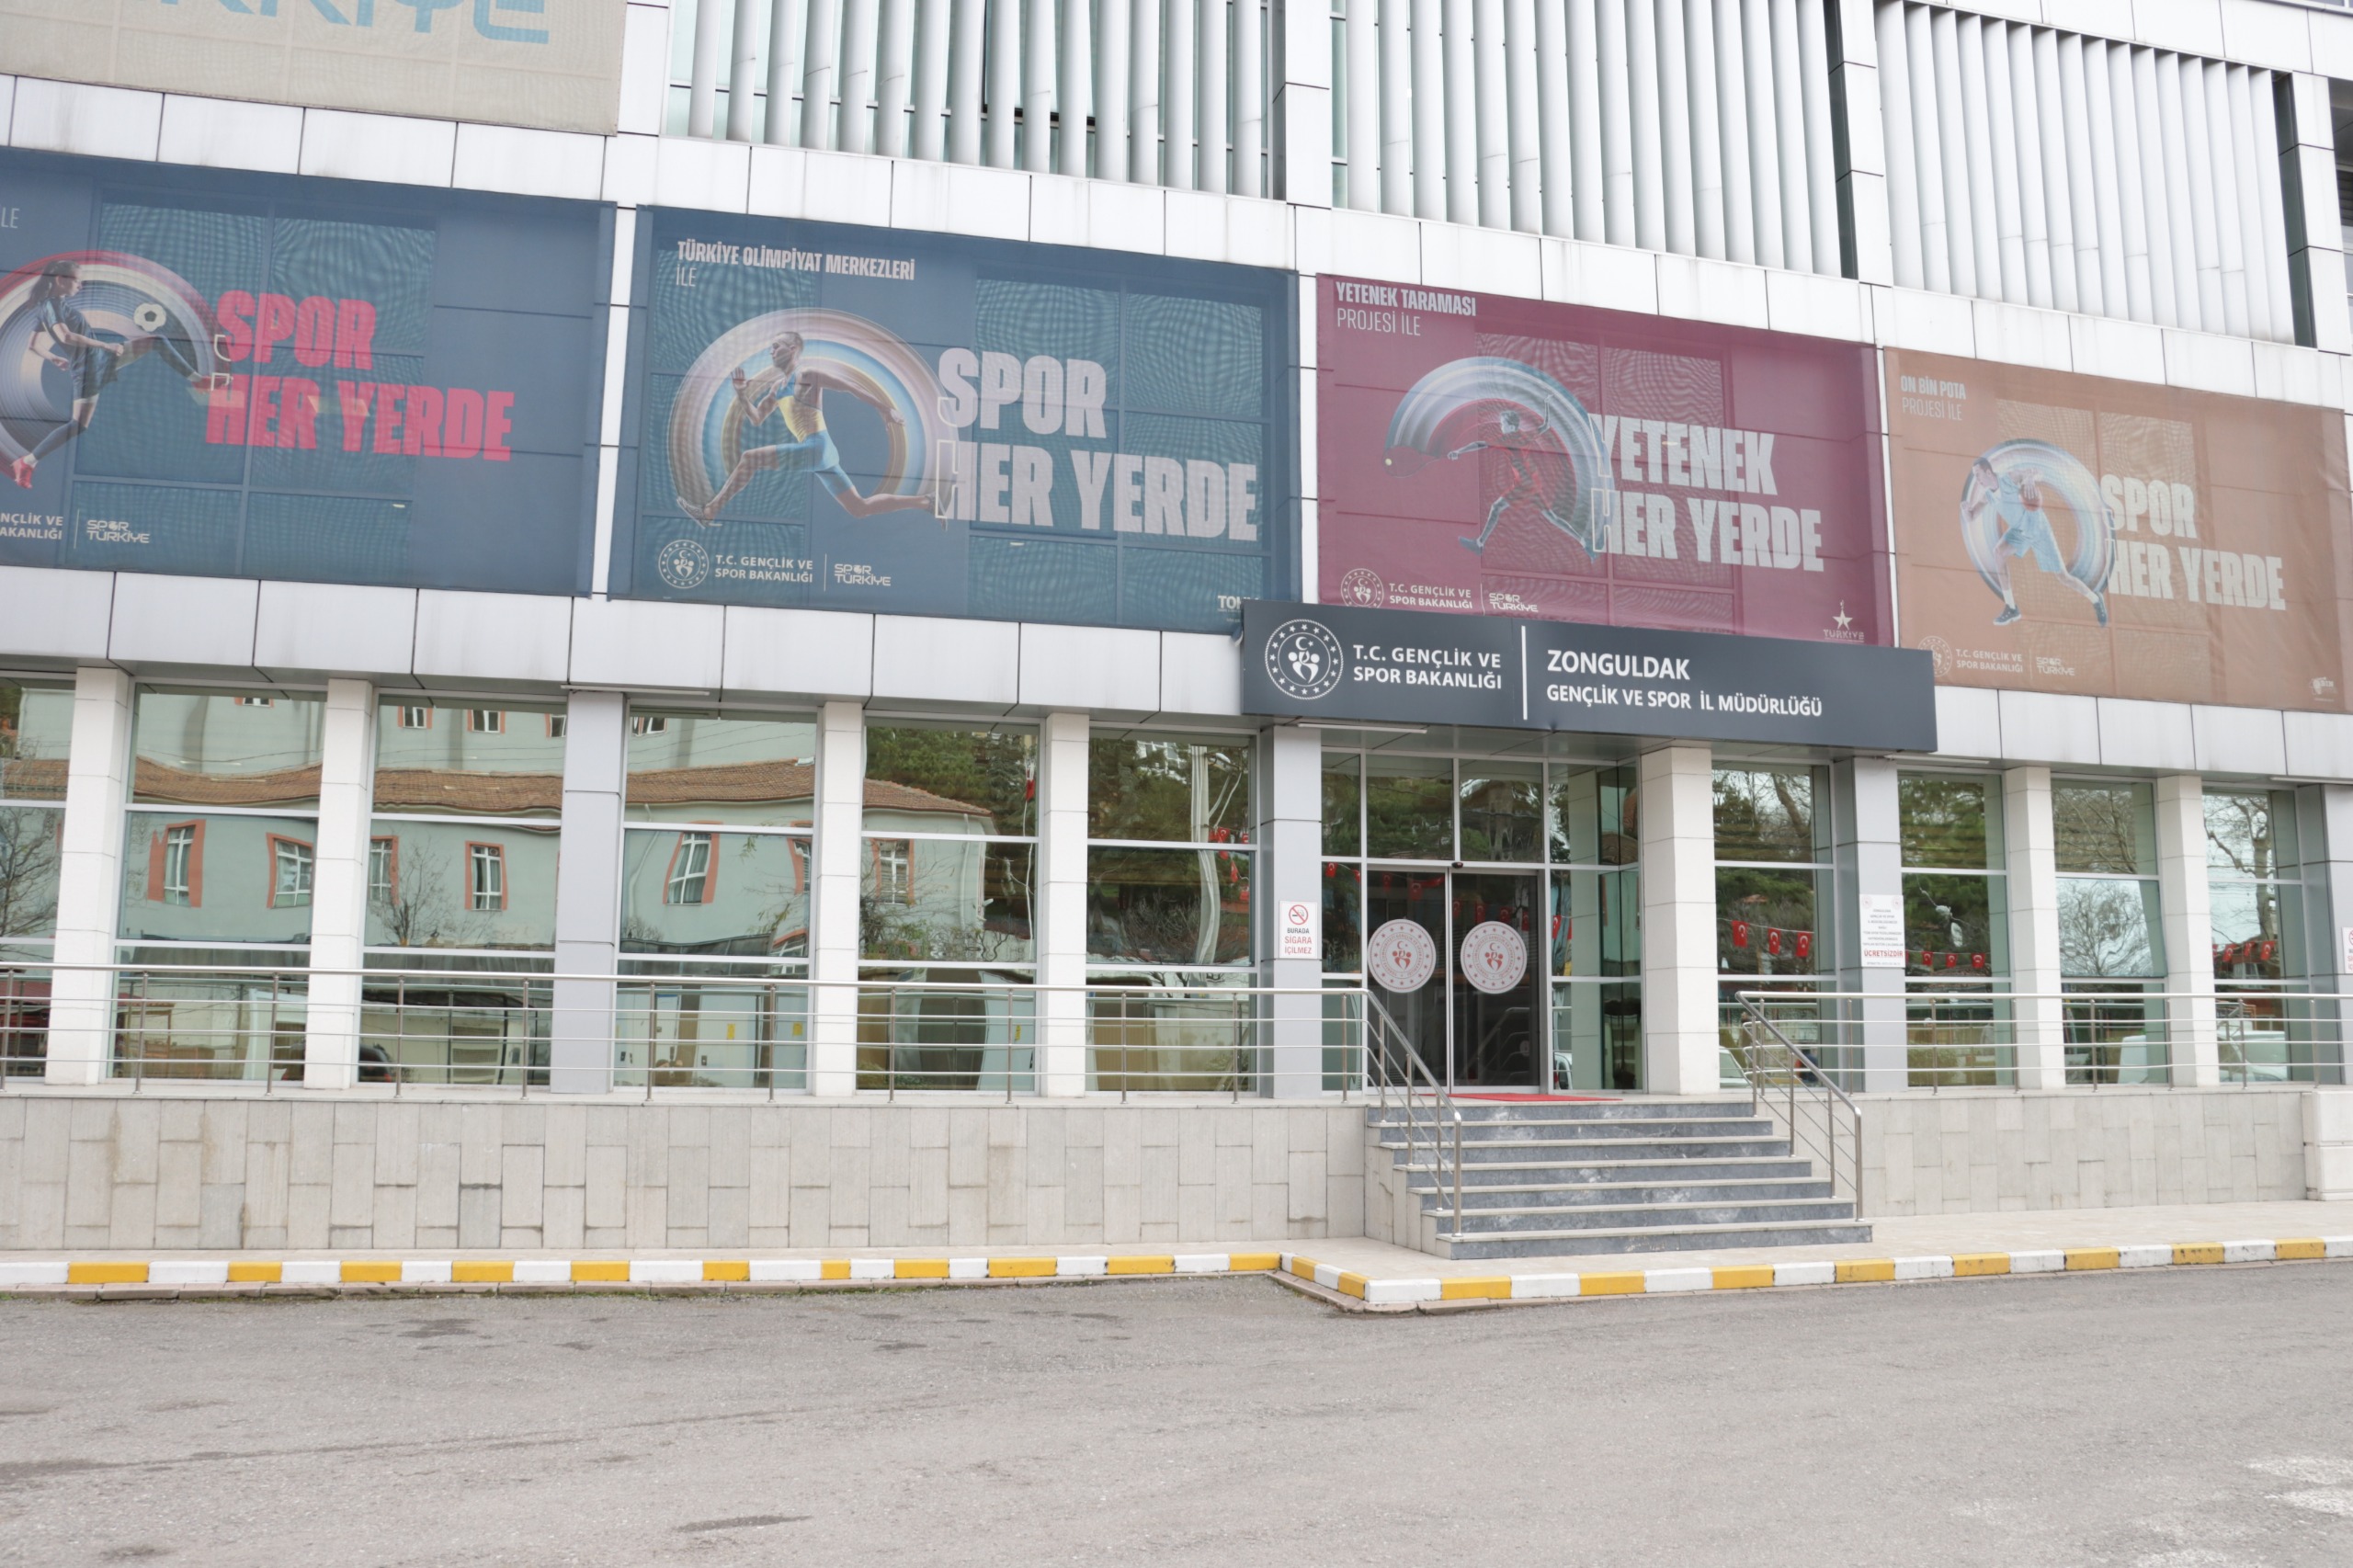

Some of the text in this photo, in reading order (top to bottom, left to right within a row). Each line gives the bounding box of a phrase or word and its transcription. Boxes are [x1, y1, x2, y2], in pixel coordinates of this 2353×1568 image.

[677, 238, 915, 280] TÜRKİYE OLİMPİYAT MERKEZLERİ
[676, 264, 697, 287] İLE
[1336, 281, 1476, 316] YETENEK TARAMASI
[214, 290, 376, 369] SPOR
[1337, 307, 1421, 336] PROJESİ İLE
[938, 347, 1108, 438] SPOR
[1900, 375, 1967, 400] ON BİN POTA
[206, 372, 515, 461] HER YERDE
[1902, 396, 1963, 421] PROJESİ İLE
[1587, 413, 1779, 495] YETENEK
[935, 439, 1257, 541] HER YERDE
[2100, 473, 2197, 539] SPOR
[46, 515, 64, 526] VE
[86, 519, 129, 532] SPOR
[1591, 488, 1824, 572] HER YERDE
[86, 528, 151, 544] TÜRKİYE
[715, 554, 813, 570] T.C. GENÇLİK VE
[835, 563, 871, 574] SPOR
[715, 568, 813, 583] SPOR BAKANLIĞI
[835, 573, 891, 586] TÜRKİYE
[2105, 538, 2286, 610] HER YERDE
[1389, 583, 1472, 598] T.C. GENÇLİK VE
[1390, 596, 1472, 609] SPOR BAKANLIĞI
[1490, 600, 1538, 612] TÜRKİYE
[1353, 644, 1501, 668] T.C. GENÇLİK VE
[1547, 649, 1690, 680] ZONGULDAK
[1956, 649, 2022, 662] T.C. GENÇLİK VE
[1956, 660, 2023, 673] SPOR BAKANLIĞI
[1353, 666, 1502, 689] SPOR BAKANLIĞI
[1547, 684, 1823, 717] GENÇLİK VE SPOR İL MÜDÜRLÜĞÜ
[1284, 946, 1312, 955] İÇİLMEZ
[1285, 936, 1313, 944] SİGARA
